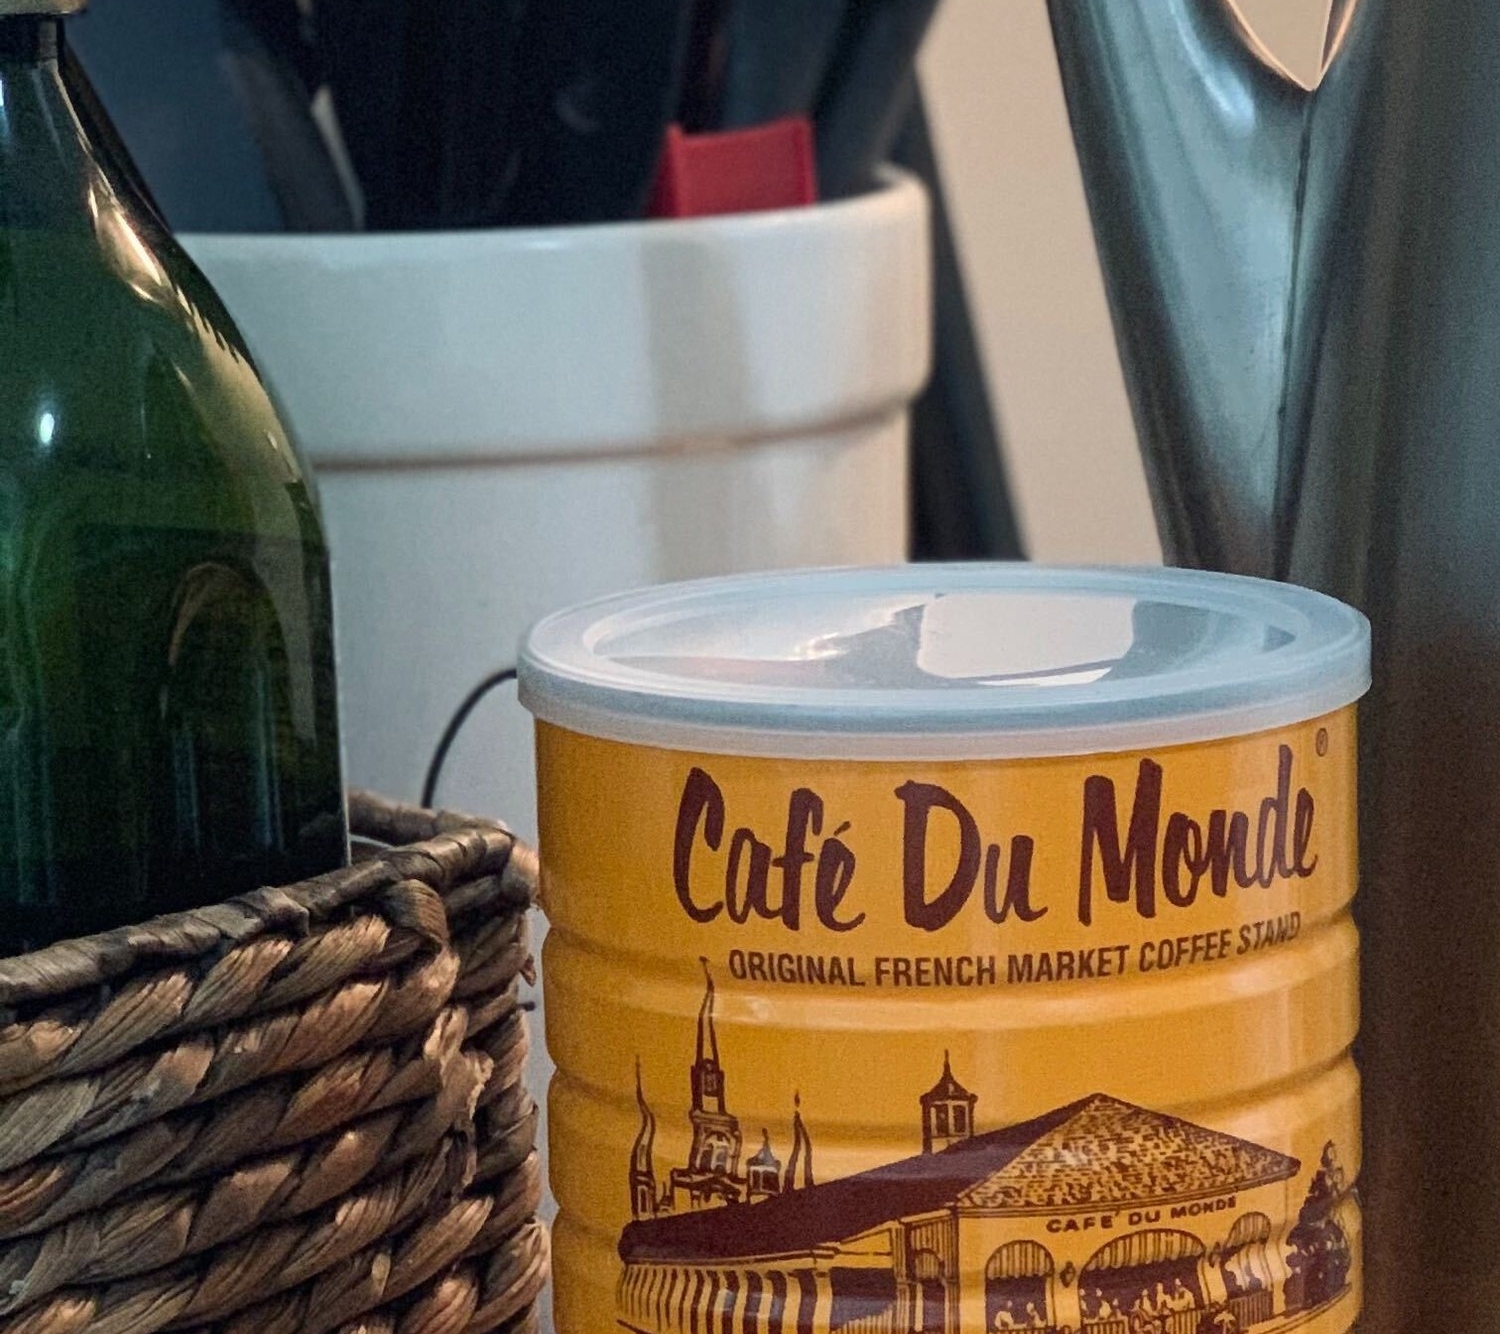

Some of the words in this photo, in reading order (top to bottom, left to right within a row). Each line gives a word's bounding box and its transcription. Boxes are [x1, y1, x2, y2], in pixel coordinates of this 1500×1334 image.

[673, 766, 866, 932] Café
[895, 779, 1048, 931] Du
[729, 947, 866, 987] ORIGINAL
[875, 954, 996, 987] FRENCH
[1007, 945, 1128, 985] MARKET
[1138, 927, 1231, 973] COFFEE
[1238, 911, 1302, 955] STAND
[1128, 1210, 1161, 1227] DU
[1170, 1196, 1238, 1219] MONDE
